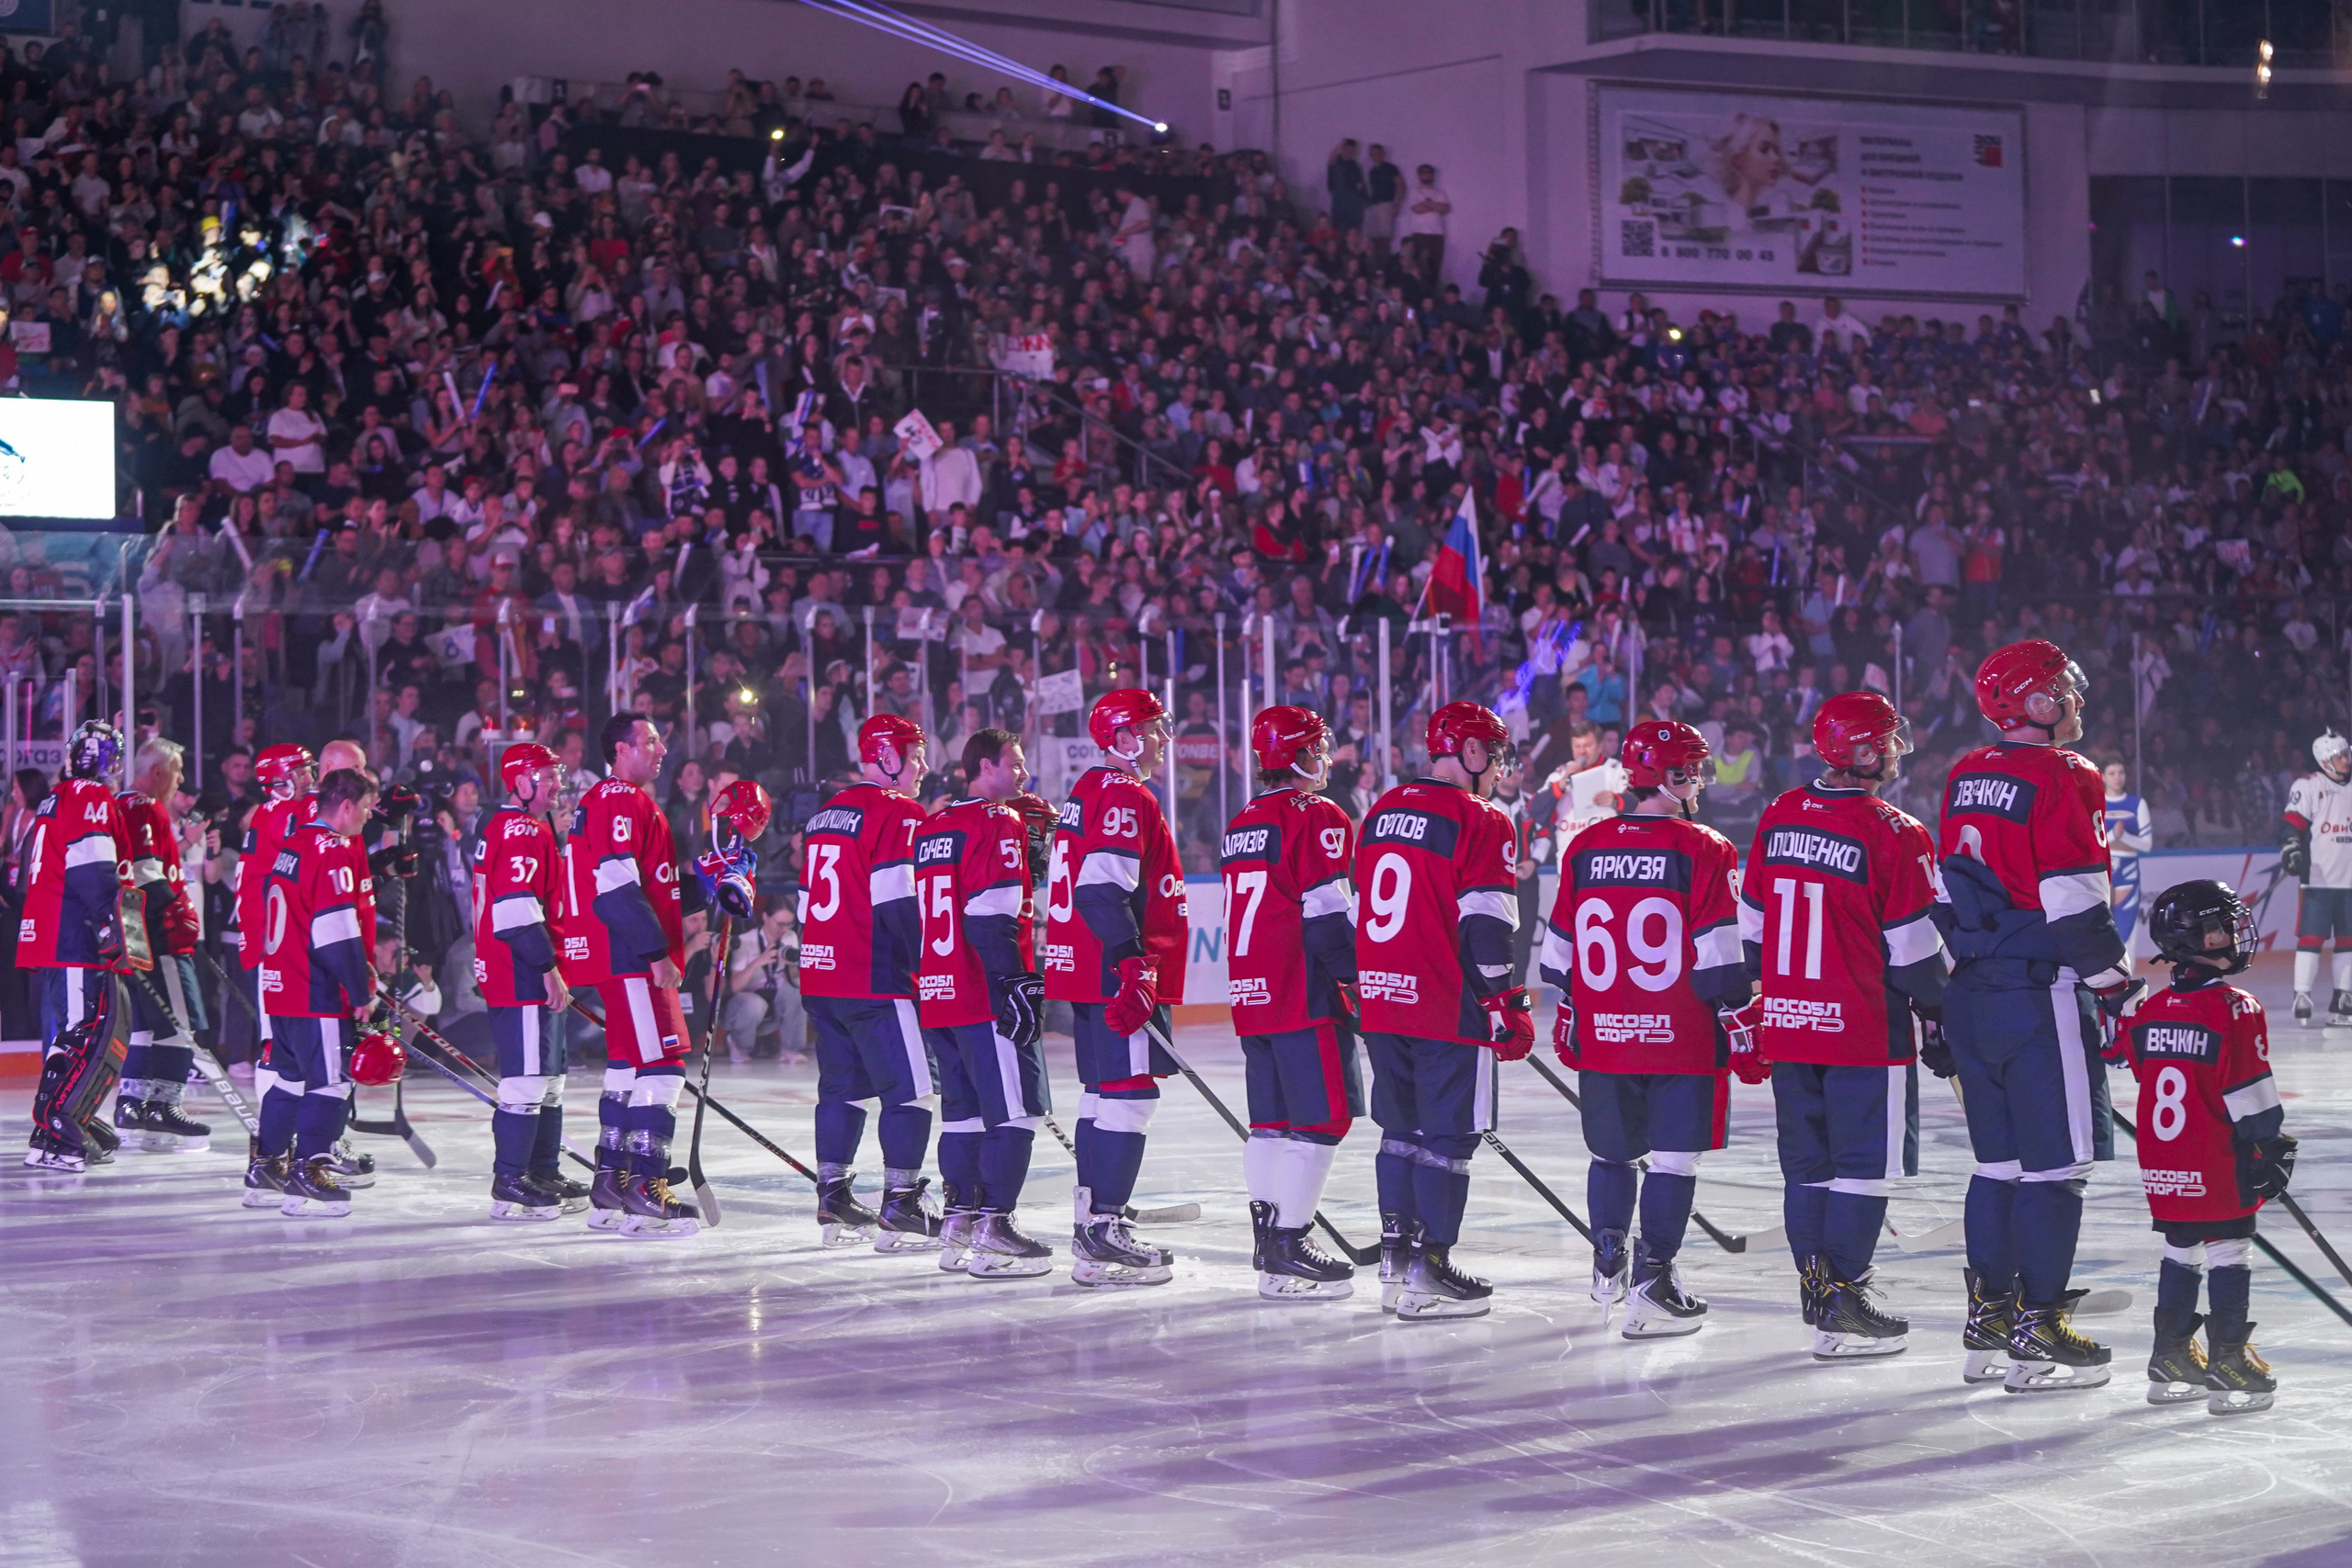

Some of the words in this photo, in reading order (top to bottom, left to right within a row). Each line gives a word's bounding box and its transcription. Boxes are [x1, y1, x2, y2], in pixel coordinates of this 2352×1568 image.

[1676, 247, 1700, 258] 800
[2013, 677, 2033, 694] CCM
[1849, 731, 1871, 740] CCM
[1176, 744, 1222, 760] ONBE
[600, 785, 636, 799] FON
[1102, 778, 1143, 789] FON
[84, 801, 108, 825] 44
[1102, 807, 1139, 839] 95
[503, 824, 539, 840] FON
[613, 815, 632, 842] 81
[1375, 813, 1428, 840] ОРЛОВ
[2091, 809, 2108, 849] 8
[2321, 820, 2352, 834] Ови
[28, 824, 47, 885] 4
[918, 837, 953, 863] СЫЧЕВ
[1319, 828, 1346, 859] 97
[510, 855, 538, 884] 37
[1501, 840, 1516, 874] 9
[1589, 855, 1667, 880] ЯРКУЗЯ
[328, 866, 355, 896] 10
[564, 843, 579, 917] 1
[1917, 852, 1935, 889] 1
[1365, 852, 1412, 943] 9
[1726, 869, 1740, 902] 6
[2199, 907, 2221, 916] CCM
[1773, 877, 1824, 980] 11
[1575, 897, 1683, 992] 69
[1764, 997, 1841, 1017] МОСОБЛ
[1593, 1013, 1670, 1028] МОСОБЛ
[214, 1079, 260, 1136] BAUE
[2153, 1066, 2187, 1142] 8
[2141, 1168, 2202, 1185] МОСОБЛ
[2143, 1181, 2187, 1197] СПОРТ
[2164, 1359, 2183, 1377] CCM
[2220, 1364, 2248, 1386] CCM
